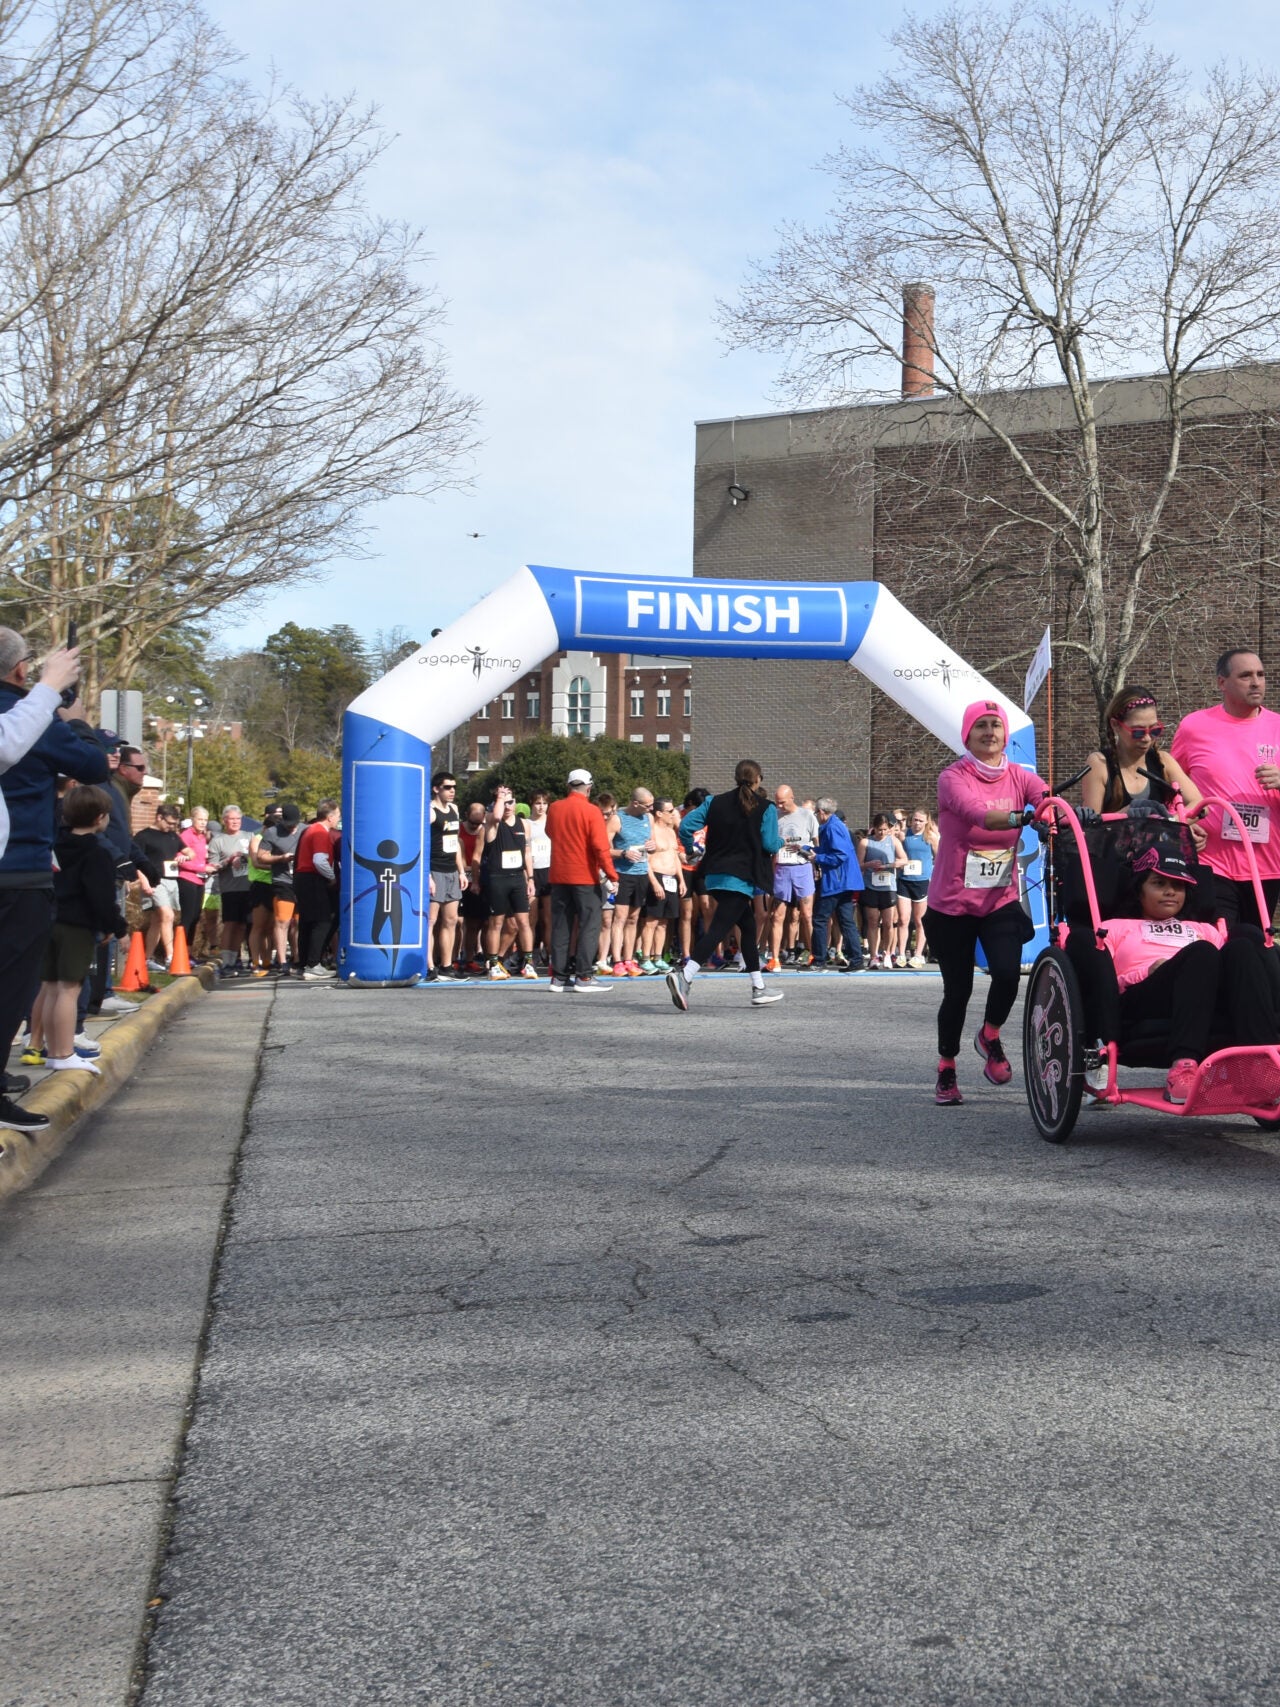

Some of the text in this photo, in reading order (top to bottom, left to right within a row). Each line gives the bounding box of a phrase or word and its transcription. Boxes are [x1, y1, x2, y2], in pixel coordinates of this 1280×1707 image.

[626, 590, 800, 634] FINISH
[1228, 812, 1259, 828] 150
[980, 861, 1003, 876] 137
[1148, 923, 1183, 934] 1349
